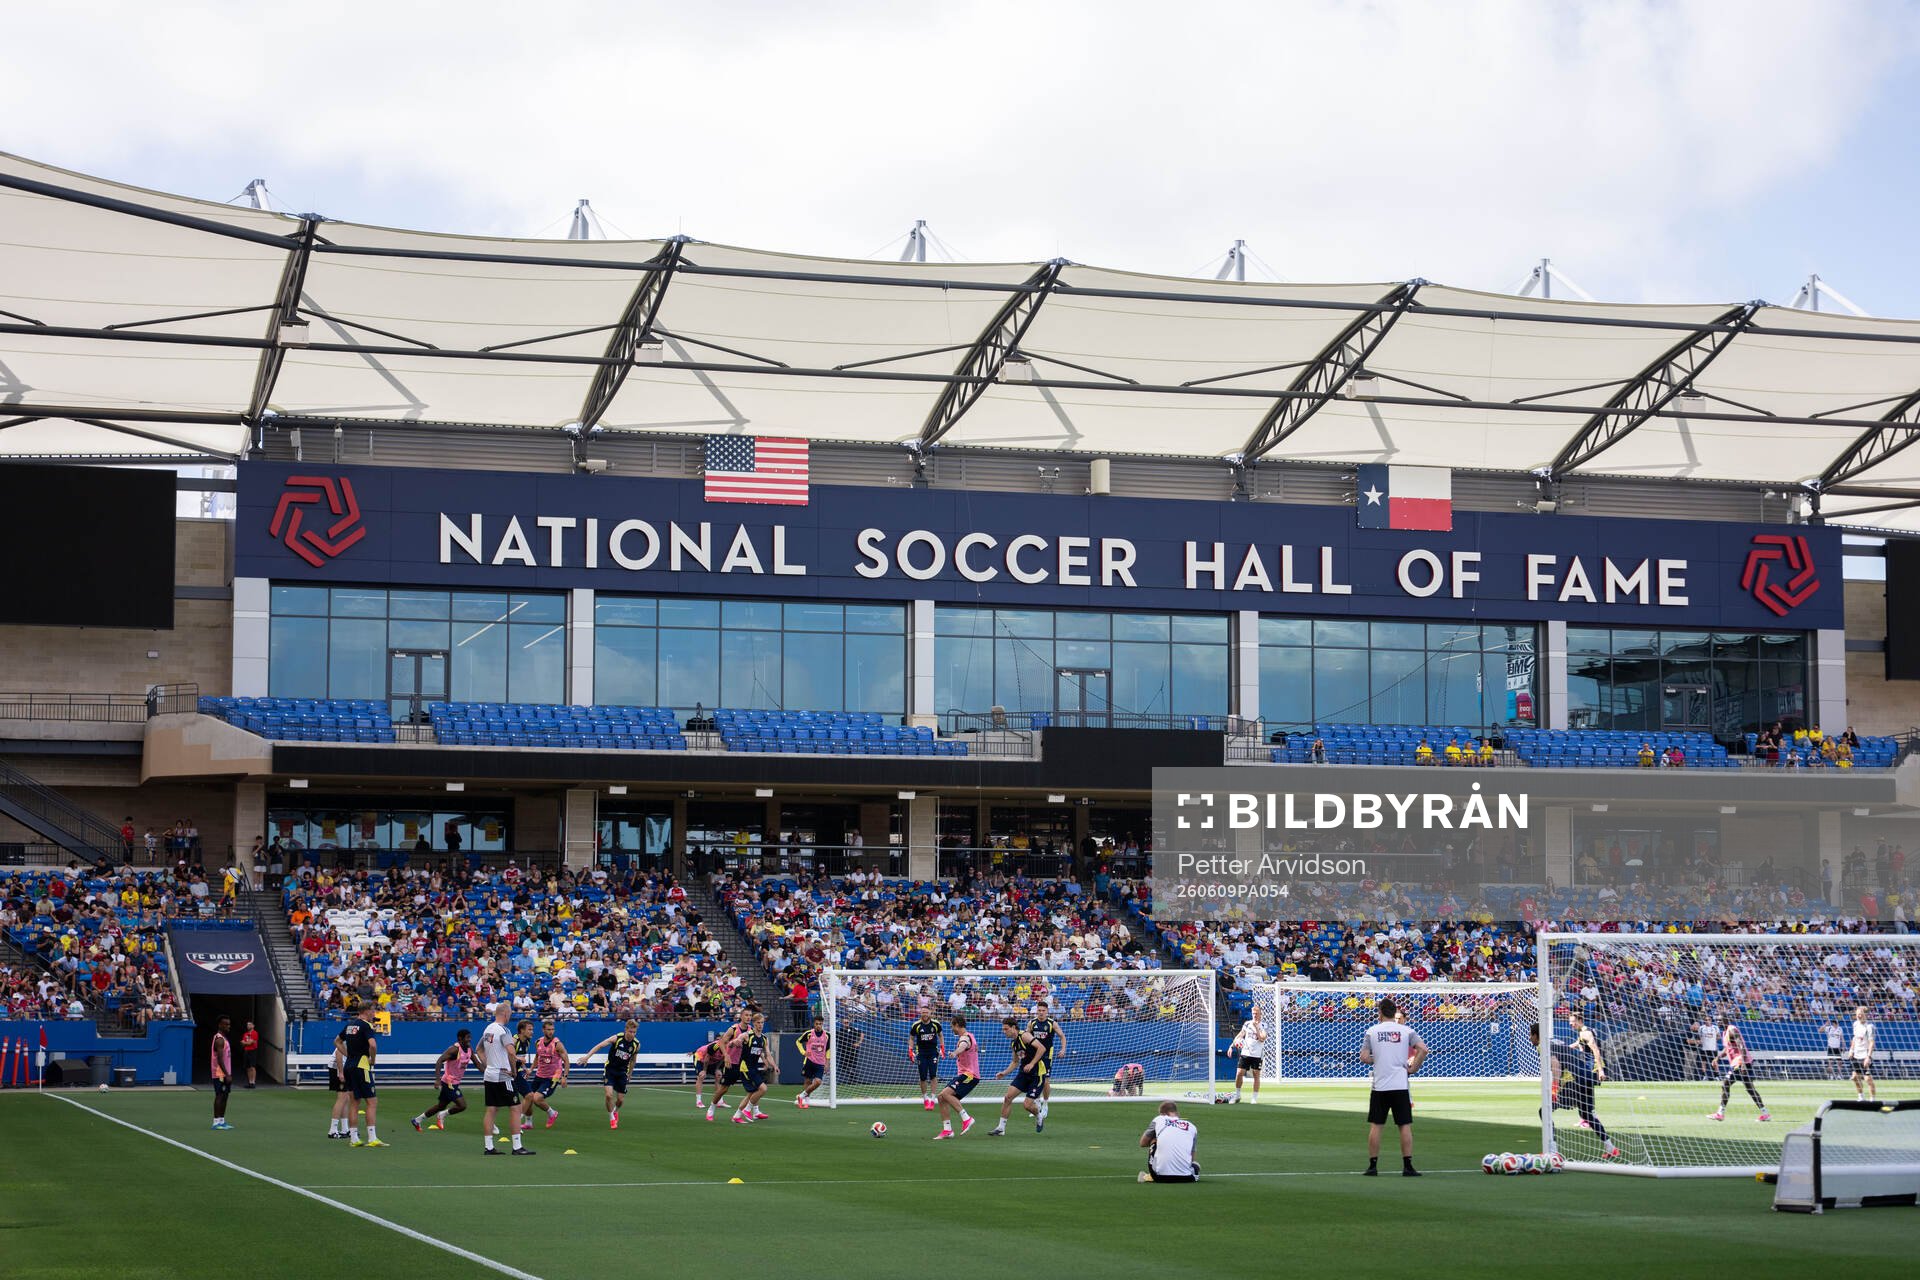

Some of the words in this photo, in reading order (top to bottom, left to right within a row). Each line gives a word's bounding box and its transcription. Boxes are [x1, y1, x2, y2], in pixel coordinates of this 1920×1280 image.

[439, 512, 807, 576] NATIONAL
[854, 528, 1138, 587] SOCCER
[1185, 541, 1352, 595] HALL
[1398, 549, 1482, 598] OF
[1527, 553, 1689, 606] FAME
